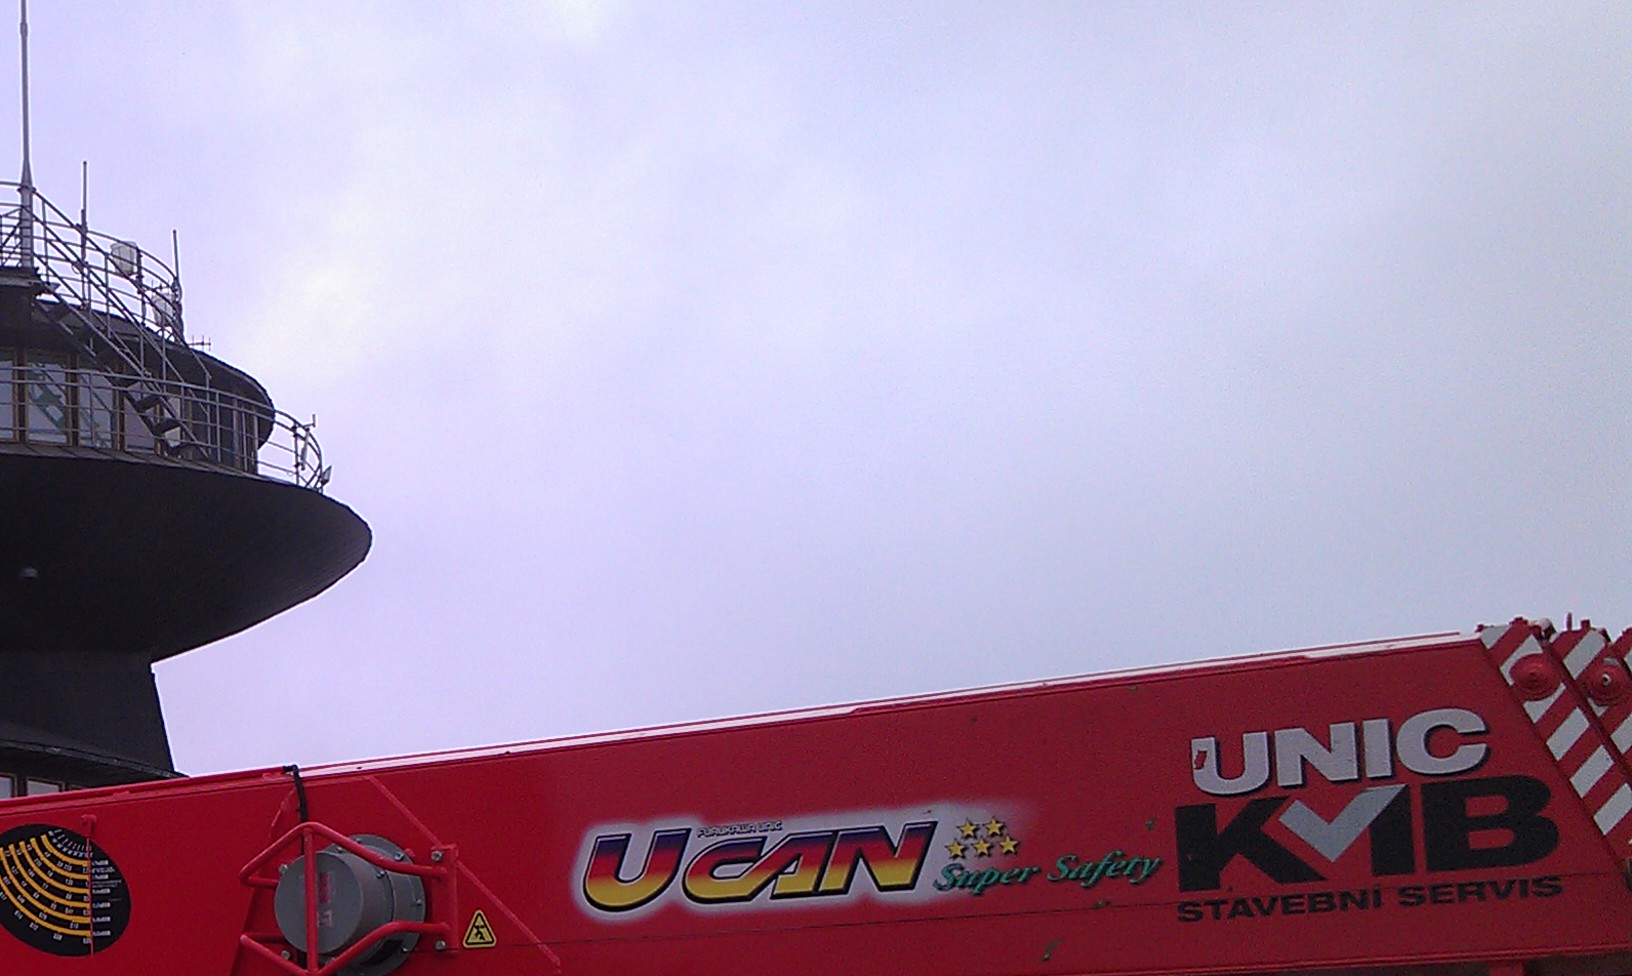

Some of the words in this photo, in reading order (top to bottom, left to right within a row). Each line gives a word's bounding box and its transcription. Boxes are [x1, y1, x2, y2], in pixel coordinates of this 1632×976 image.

[1191, 708, 1489, 796] UNIC
[582, 820, 939, 913] UCAN
[932, 862, 1041, 895] Super
[1047, 849, 1163, 888] Safety
[1174, 774, 1560, 892] KMB
[1397, 876, 1563, 907] SERVIS
